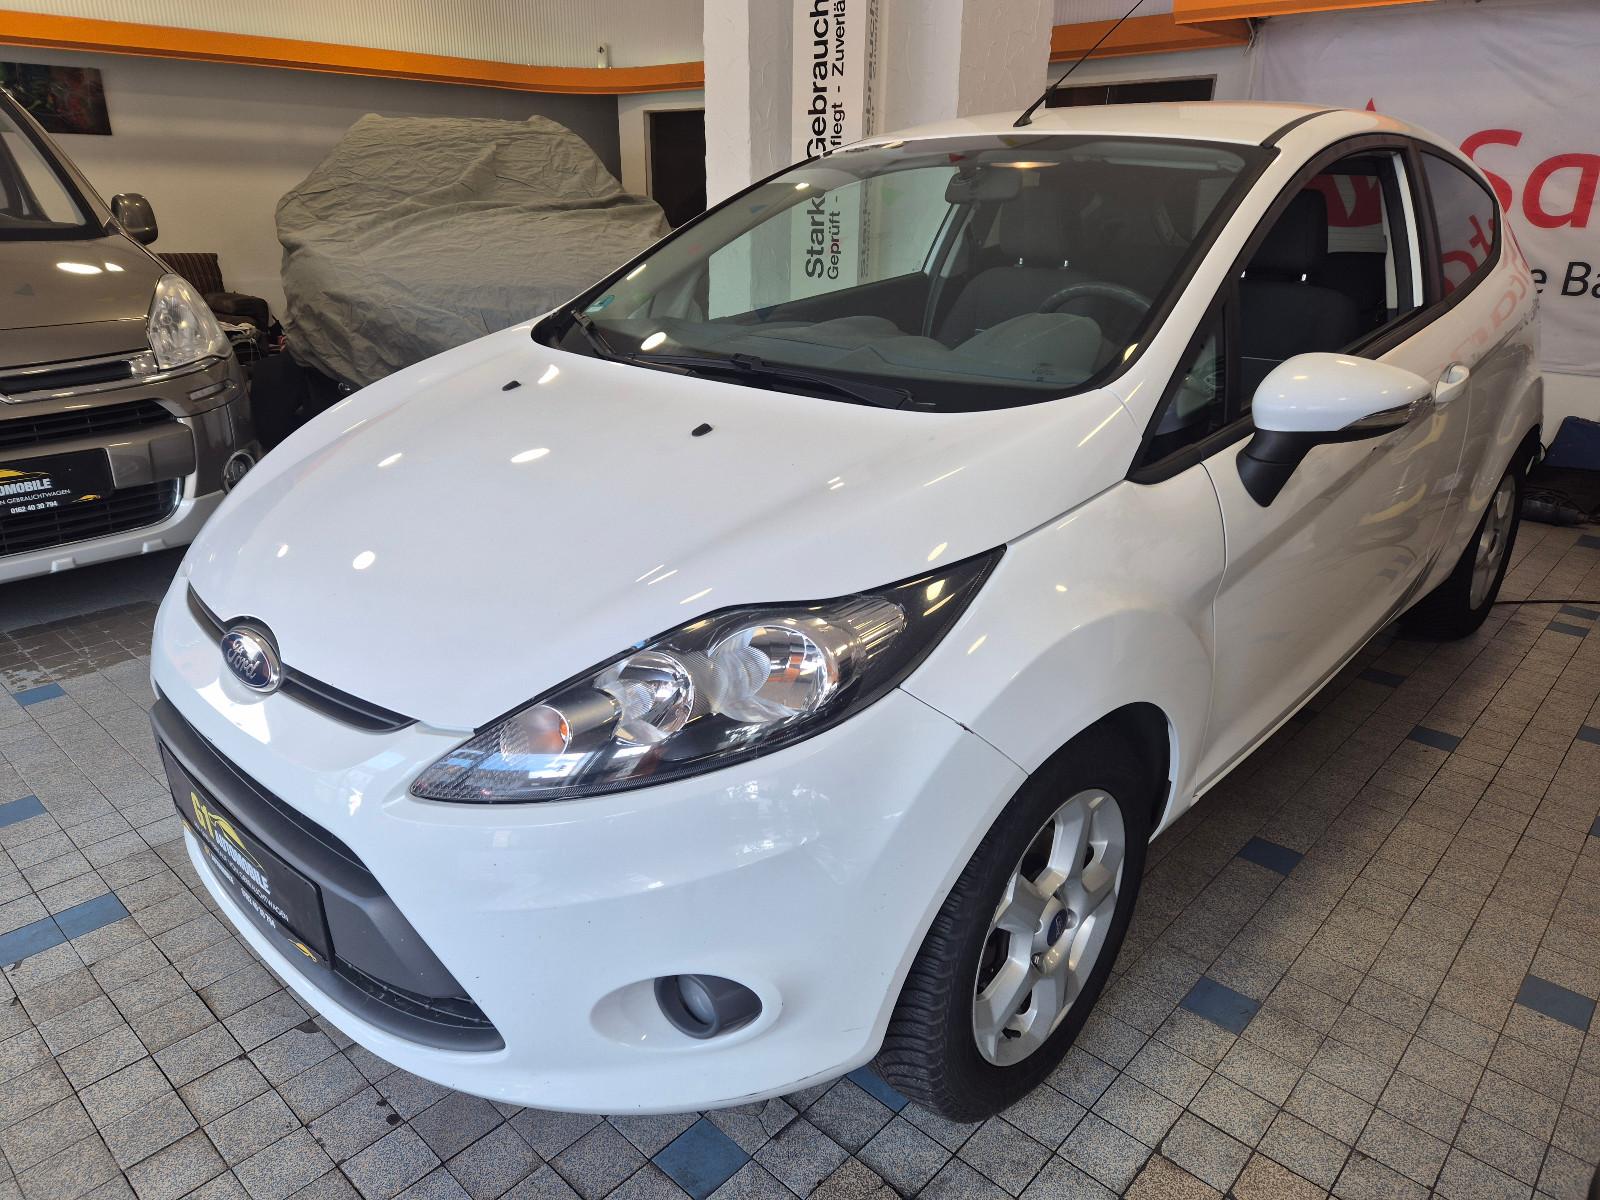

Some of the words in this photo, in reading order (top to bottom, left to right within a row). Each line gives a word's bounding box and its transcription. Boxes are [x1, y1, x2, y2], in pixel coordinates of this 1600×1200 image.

[832, 0, 846, 77] Zuverlä
[806, 0, 829, 159] Gebrauch
[830, 101, 846, 147] flegt
[1459, 129, 1600, 229] Sa
[805, 194, 826, 279] Stark
[827, 211, 841, 280] Geprüft
[227, 638, 260, 680] Ford
